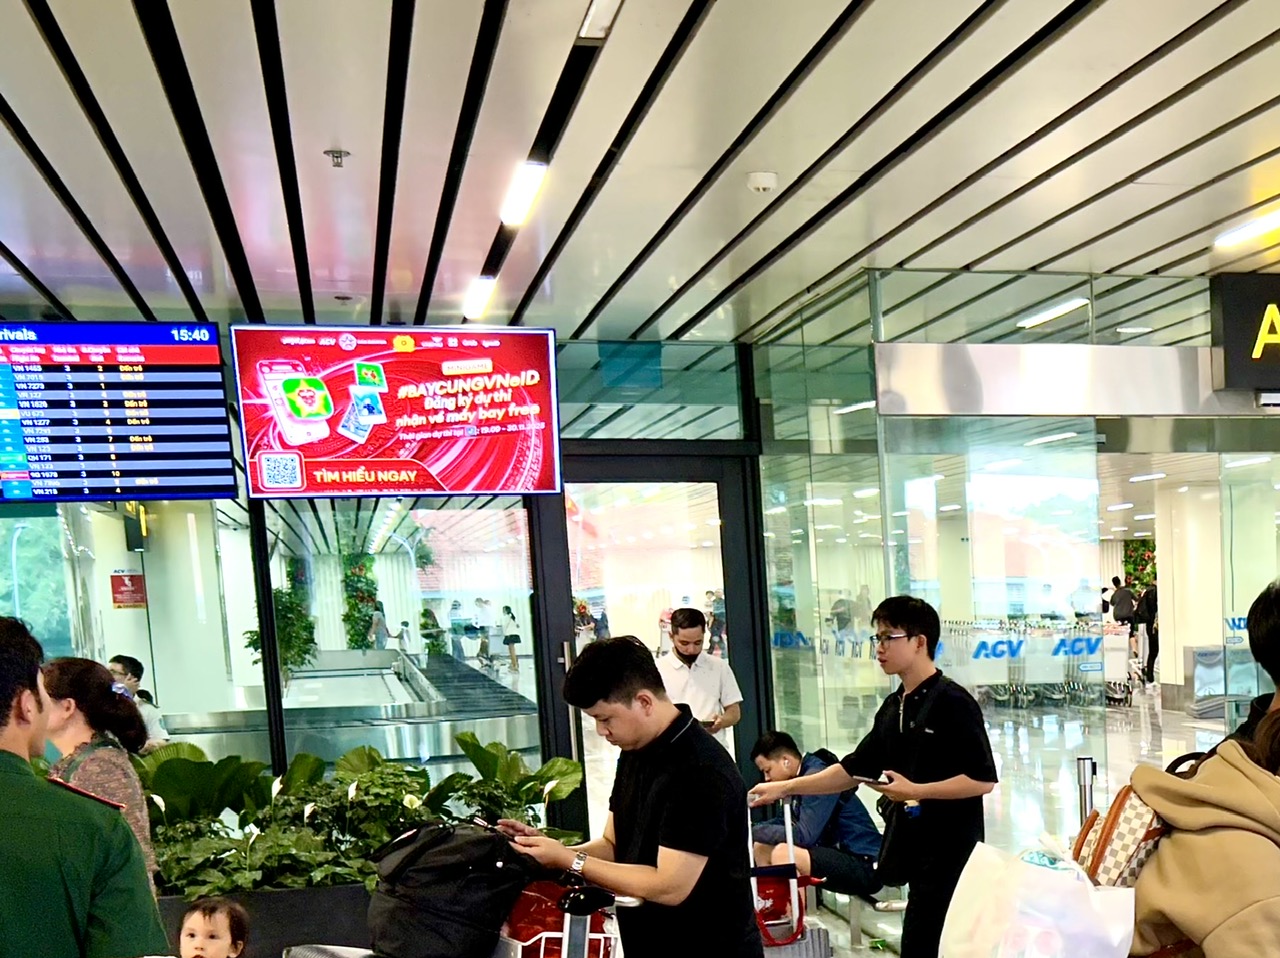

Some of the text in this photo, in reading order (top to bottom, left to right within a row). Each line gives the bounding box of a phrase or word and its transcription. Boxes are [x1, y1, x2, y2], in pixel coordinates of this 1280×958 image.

[171, 328, 210, 341] 15:40
[478, 407, 507, 420] bay
[508, 402, 540, 416] free
[313, 465, 418, 483] TÌM HIỂU NGAY
[972, 639, 1024, 659] ACV
[1051, 636, 1103, 656] ACV
